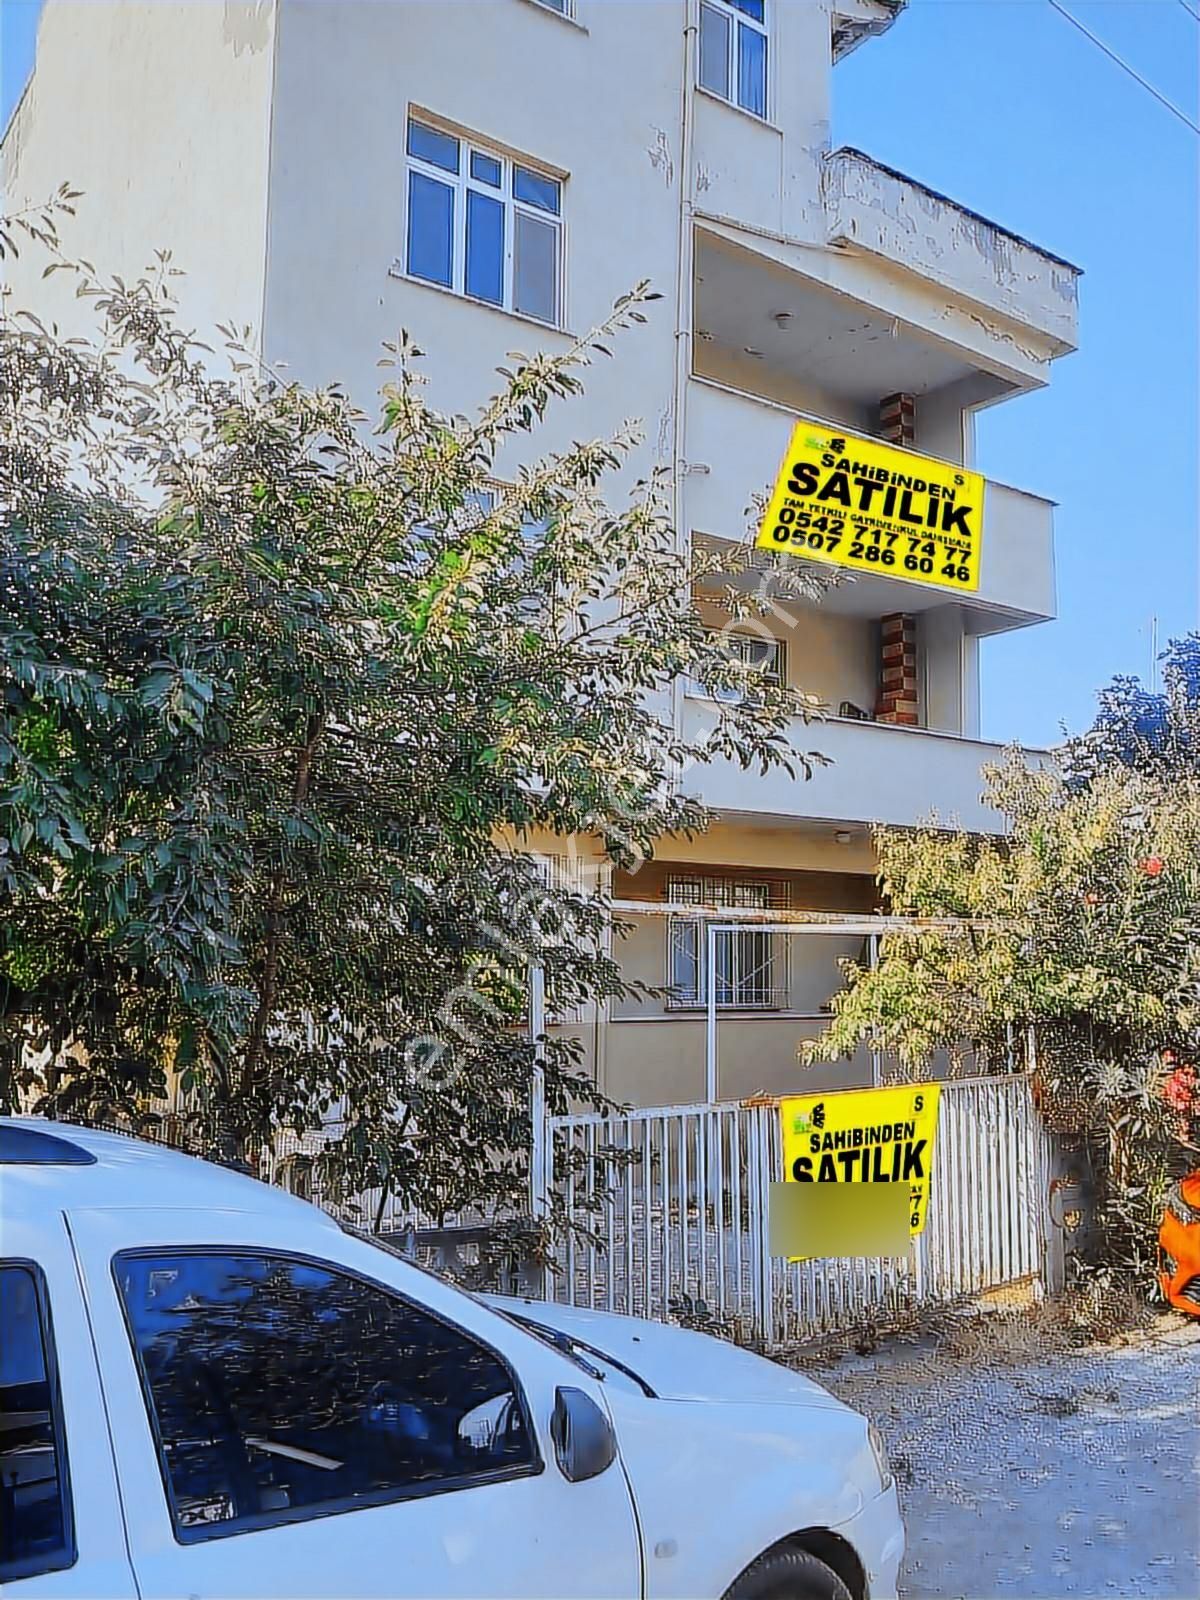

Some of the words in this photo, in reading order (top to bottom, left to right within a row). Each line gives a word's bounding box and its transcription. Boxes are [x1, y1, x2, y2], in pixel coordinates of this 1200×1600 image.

[788, 462, 973, 537] SATILIK
[773, 525, 841, 553] 0507
[848, 542, 895, 565] 286
[904, 556, 933, 573] 60
[941, 563, 970, 582] 46
[779, 508, 845, 535] 0542
[854, 524, 899, 547] 717
[908, 538, 936, 557] 74
[944, 546, 972, 564] 77
[914, 1095, 924, 1112] S
